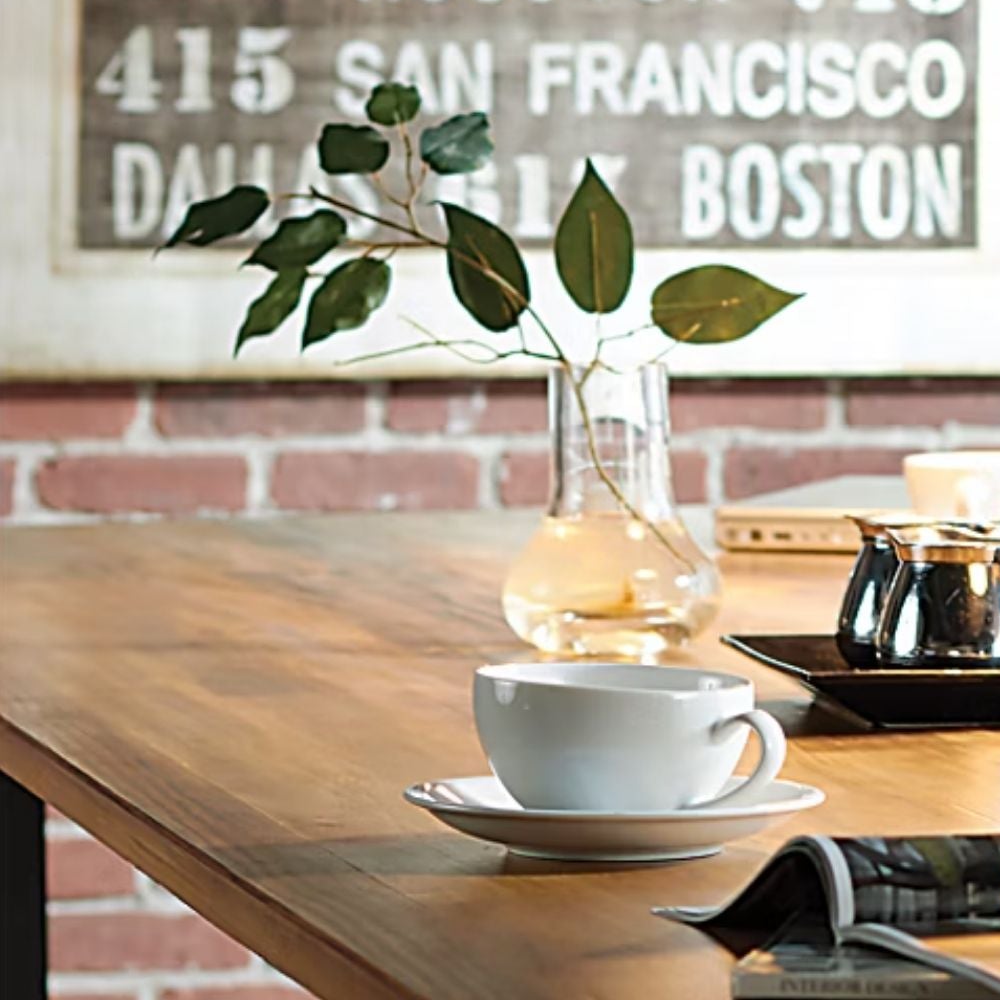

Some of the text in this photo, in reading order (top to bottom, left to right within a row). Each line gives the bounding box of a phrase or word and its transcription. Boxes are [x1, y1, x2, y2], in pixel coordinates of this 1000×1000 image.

[95, 25, 296, 115] 415
[333, 37, 966, 120] SAN FRANCISCO
[680, 141, 963, 241] BOSTON
